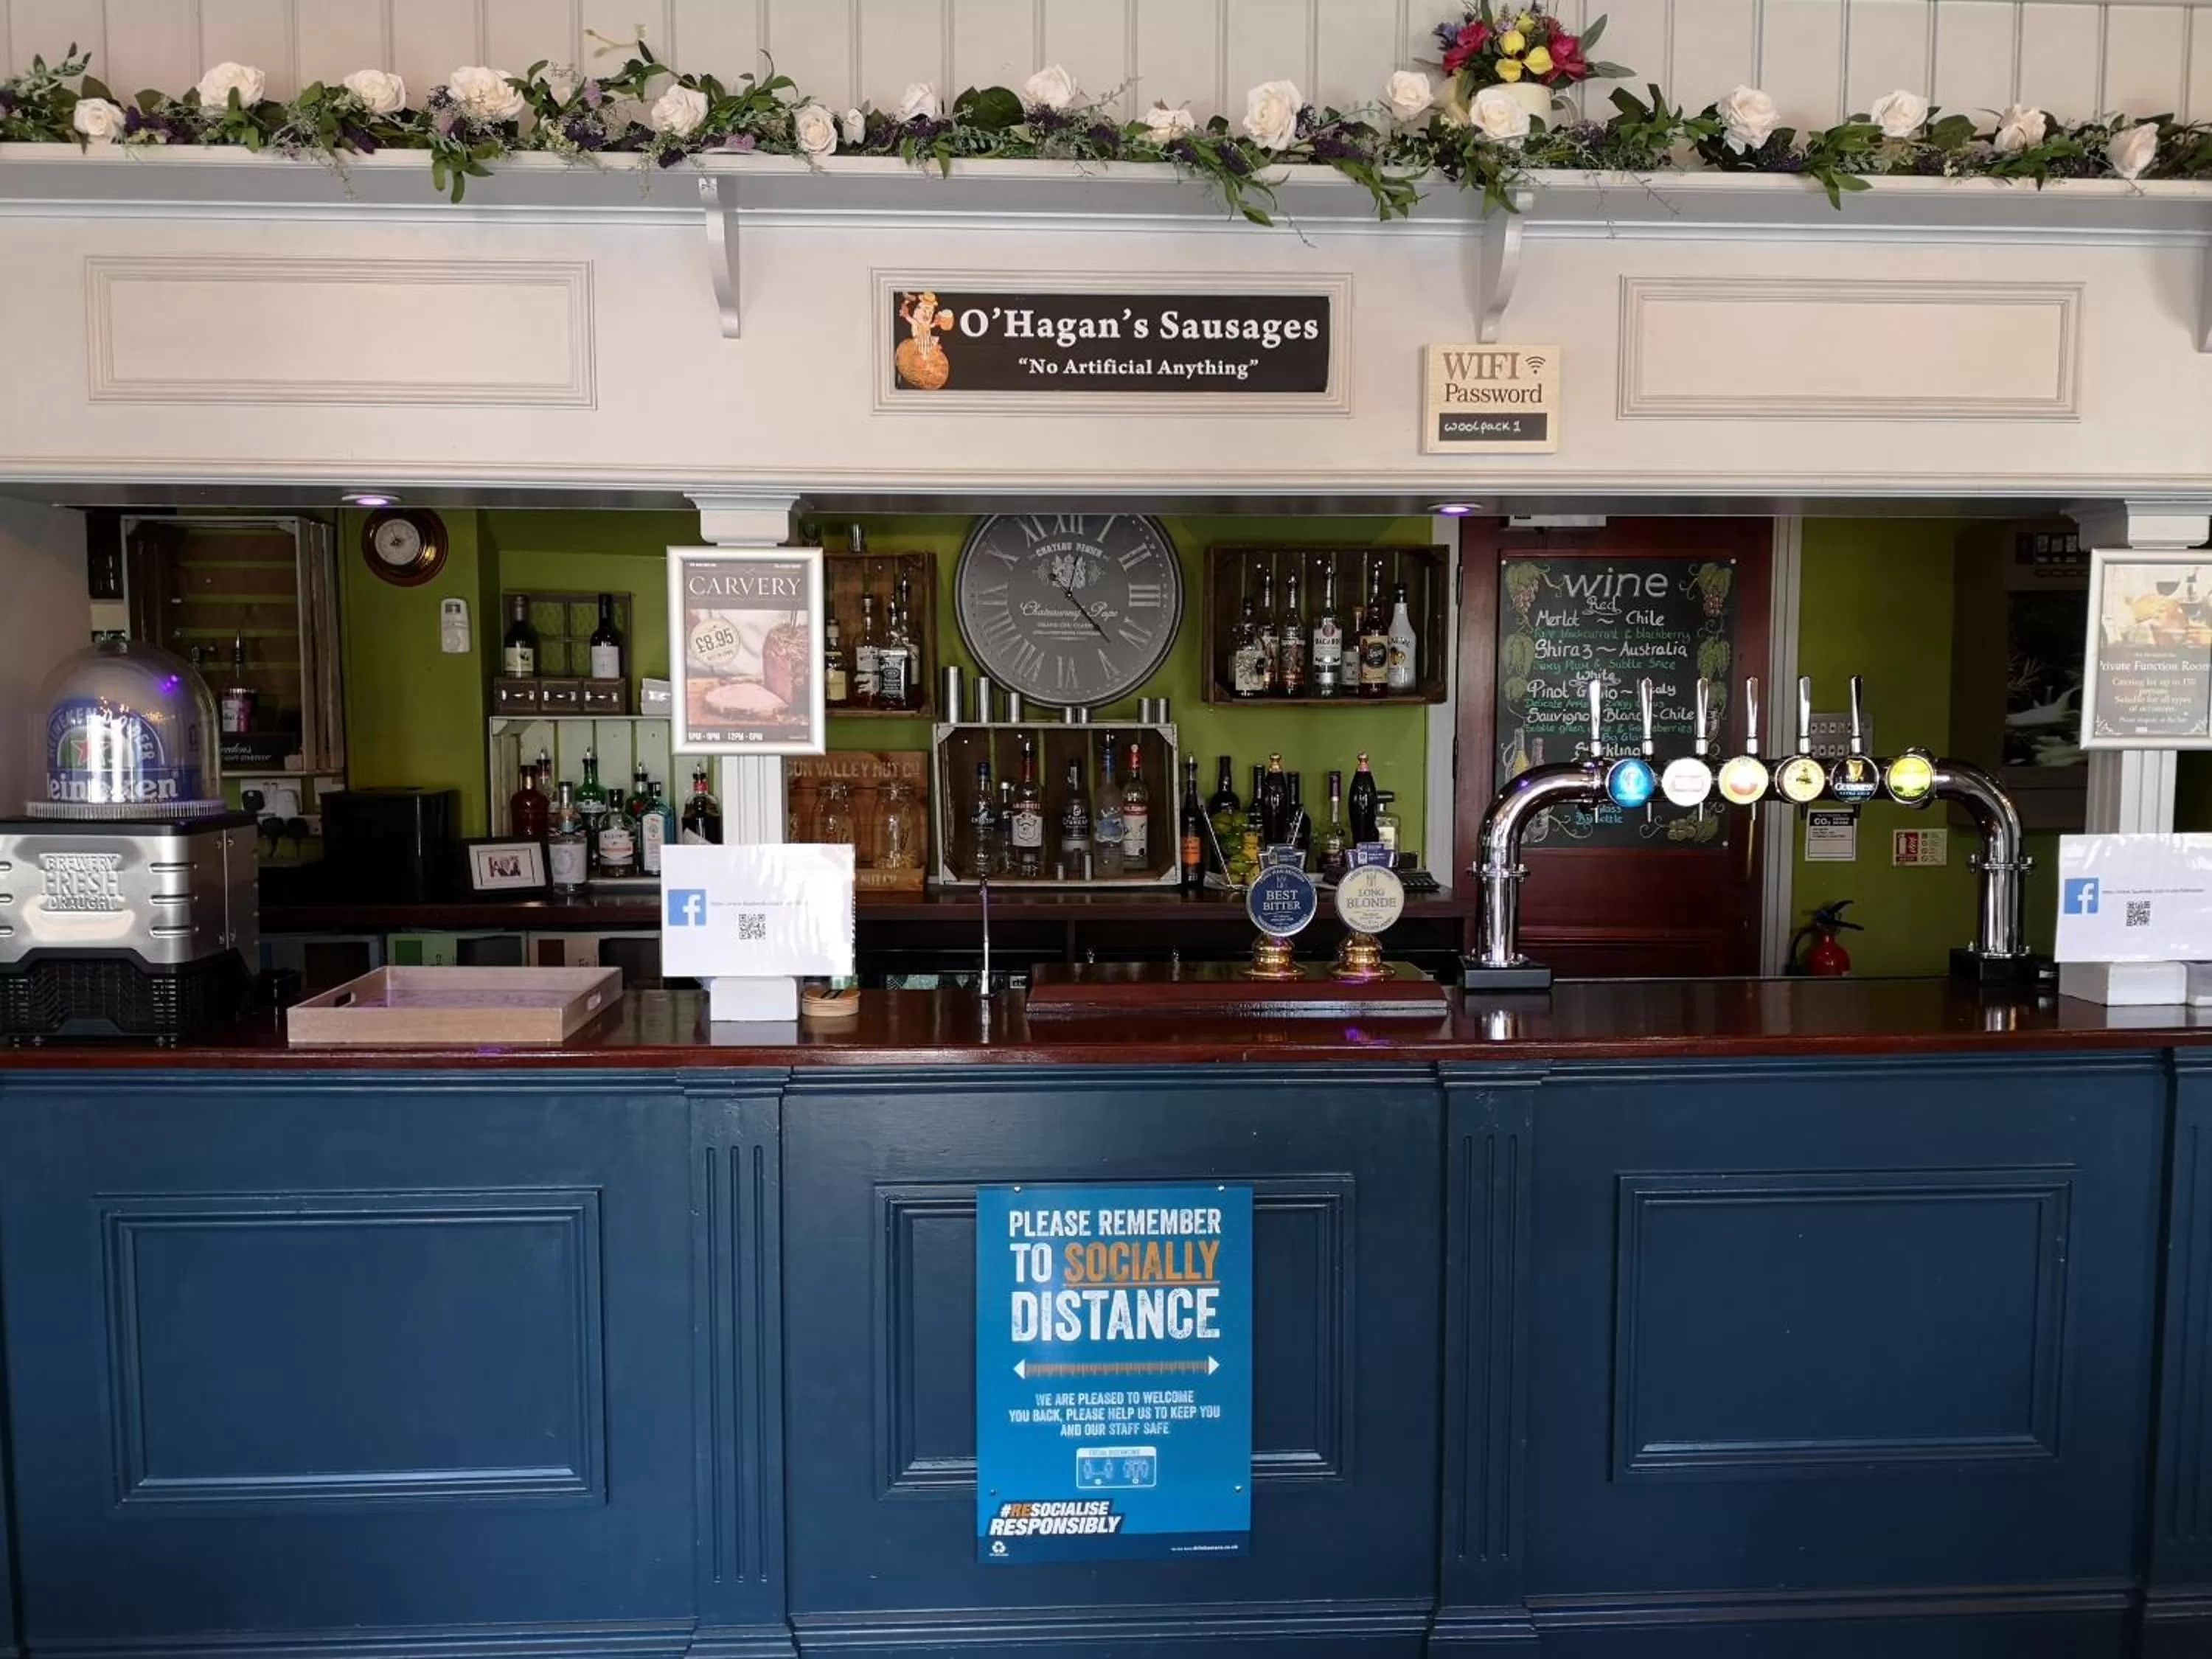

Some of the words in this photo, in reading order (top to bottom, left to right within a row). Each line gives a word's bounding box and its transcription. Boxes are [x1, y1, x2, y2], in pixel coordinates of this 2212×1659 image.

[1160, 310, 1320, 349] Sausages
[1018, 358, 1059, 375] "No
[1062, 358, 1153, 375] Artificial
[1157, 358, 1259, 380] Anything"
[1443, 352, 1521, 380] WIFI
[1444, 383, 1543, 403] Password
[689, 576, 801, 597] CARVERY
[1563, 567, 1669, 598] wine
[1626, 610, 1665, 626] Chile
[695, 627, 734, 653] £8.95
[1618, 639, 1688, 658] Australia
[2135, 660, 2178, 671] Function
[1527, 678, 1570, 699] Pinot
[1527, 707, 1593, 725] Sauvigno
[1660, 706, 1695, 722] Chile
[815, 761, 869, 779] VALLEY
[46, 856, 116, 871] BREWERY
[42, 871, 122, 895] FRESH
[1357, 887, 1385, 897] LONG
[47, 895, 118, 910] DRAUGHT
[1266, 889, 1298, 900] BEST
[1346, 897, 1397, 909] BLONDE
[1262, 900, 1301, 911] BITTER
[1009, 1210, 1091, 1237] PLEASE
[1099, 1208, 1221, 1236] REMEMBER
[1009, 1242, 1052, 1282] TO
[1064, 1239, 1220, 1284] SOCIALLY
[1011, 1288, 1220, 1341] DISTANCE
[1035, 1393, 1053, 1406] WE
[1055, 1393, 1075, 1406] ARE
[1077, 1391, 1124, 1405] PLEASED
[1126, 1391, 1141, 1404] TO
[1143, 1390, 1194, 1404] WELCOME
[1009, 1409, 1030, 1423] YOU
[1032, 1408, 1062, 1423] BACK,
[1065, 1408, 1104, 1421] PLEASE
[1107, 1407, 1135, 1420] HELP
[1138, 1407, 1151, 1419] US
[1154, 1406, 1168, 1419] TO
[1170, 1405, 1197, 1419] KEEP
[1200, 1405, 1220, 1418] YOU
[1060, 1424, 1082, 1438] AND
[1084, 1423, 1107, 1437] OUR
[1108, 1422, 1141, 1436] STAFF
[1142, 1422, 1169, 1435] SAFE
[1000, 1500, 1110, 1518] #RESOCIALISE
[990, 1516, 1121, 1536] RESPONSIBLY
